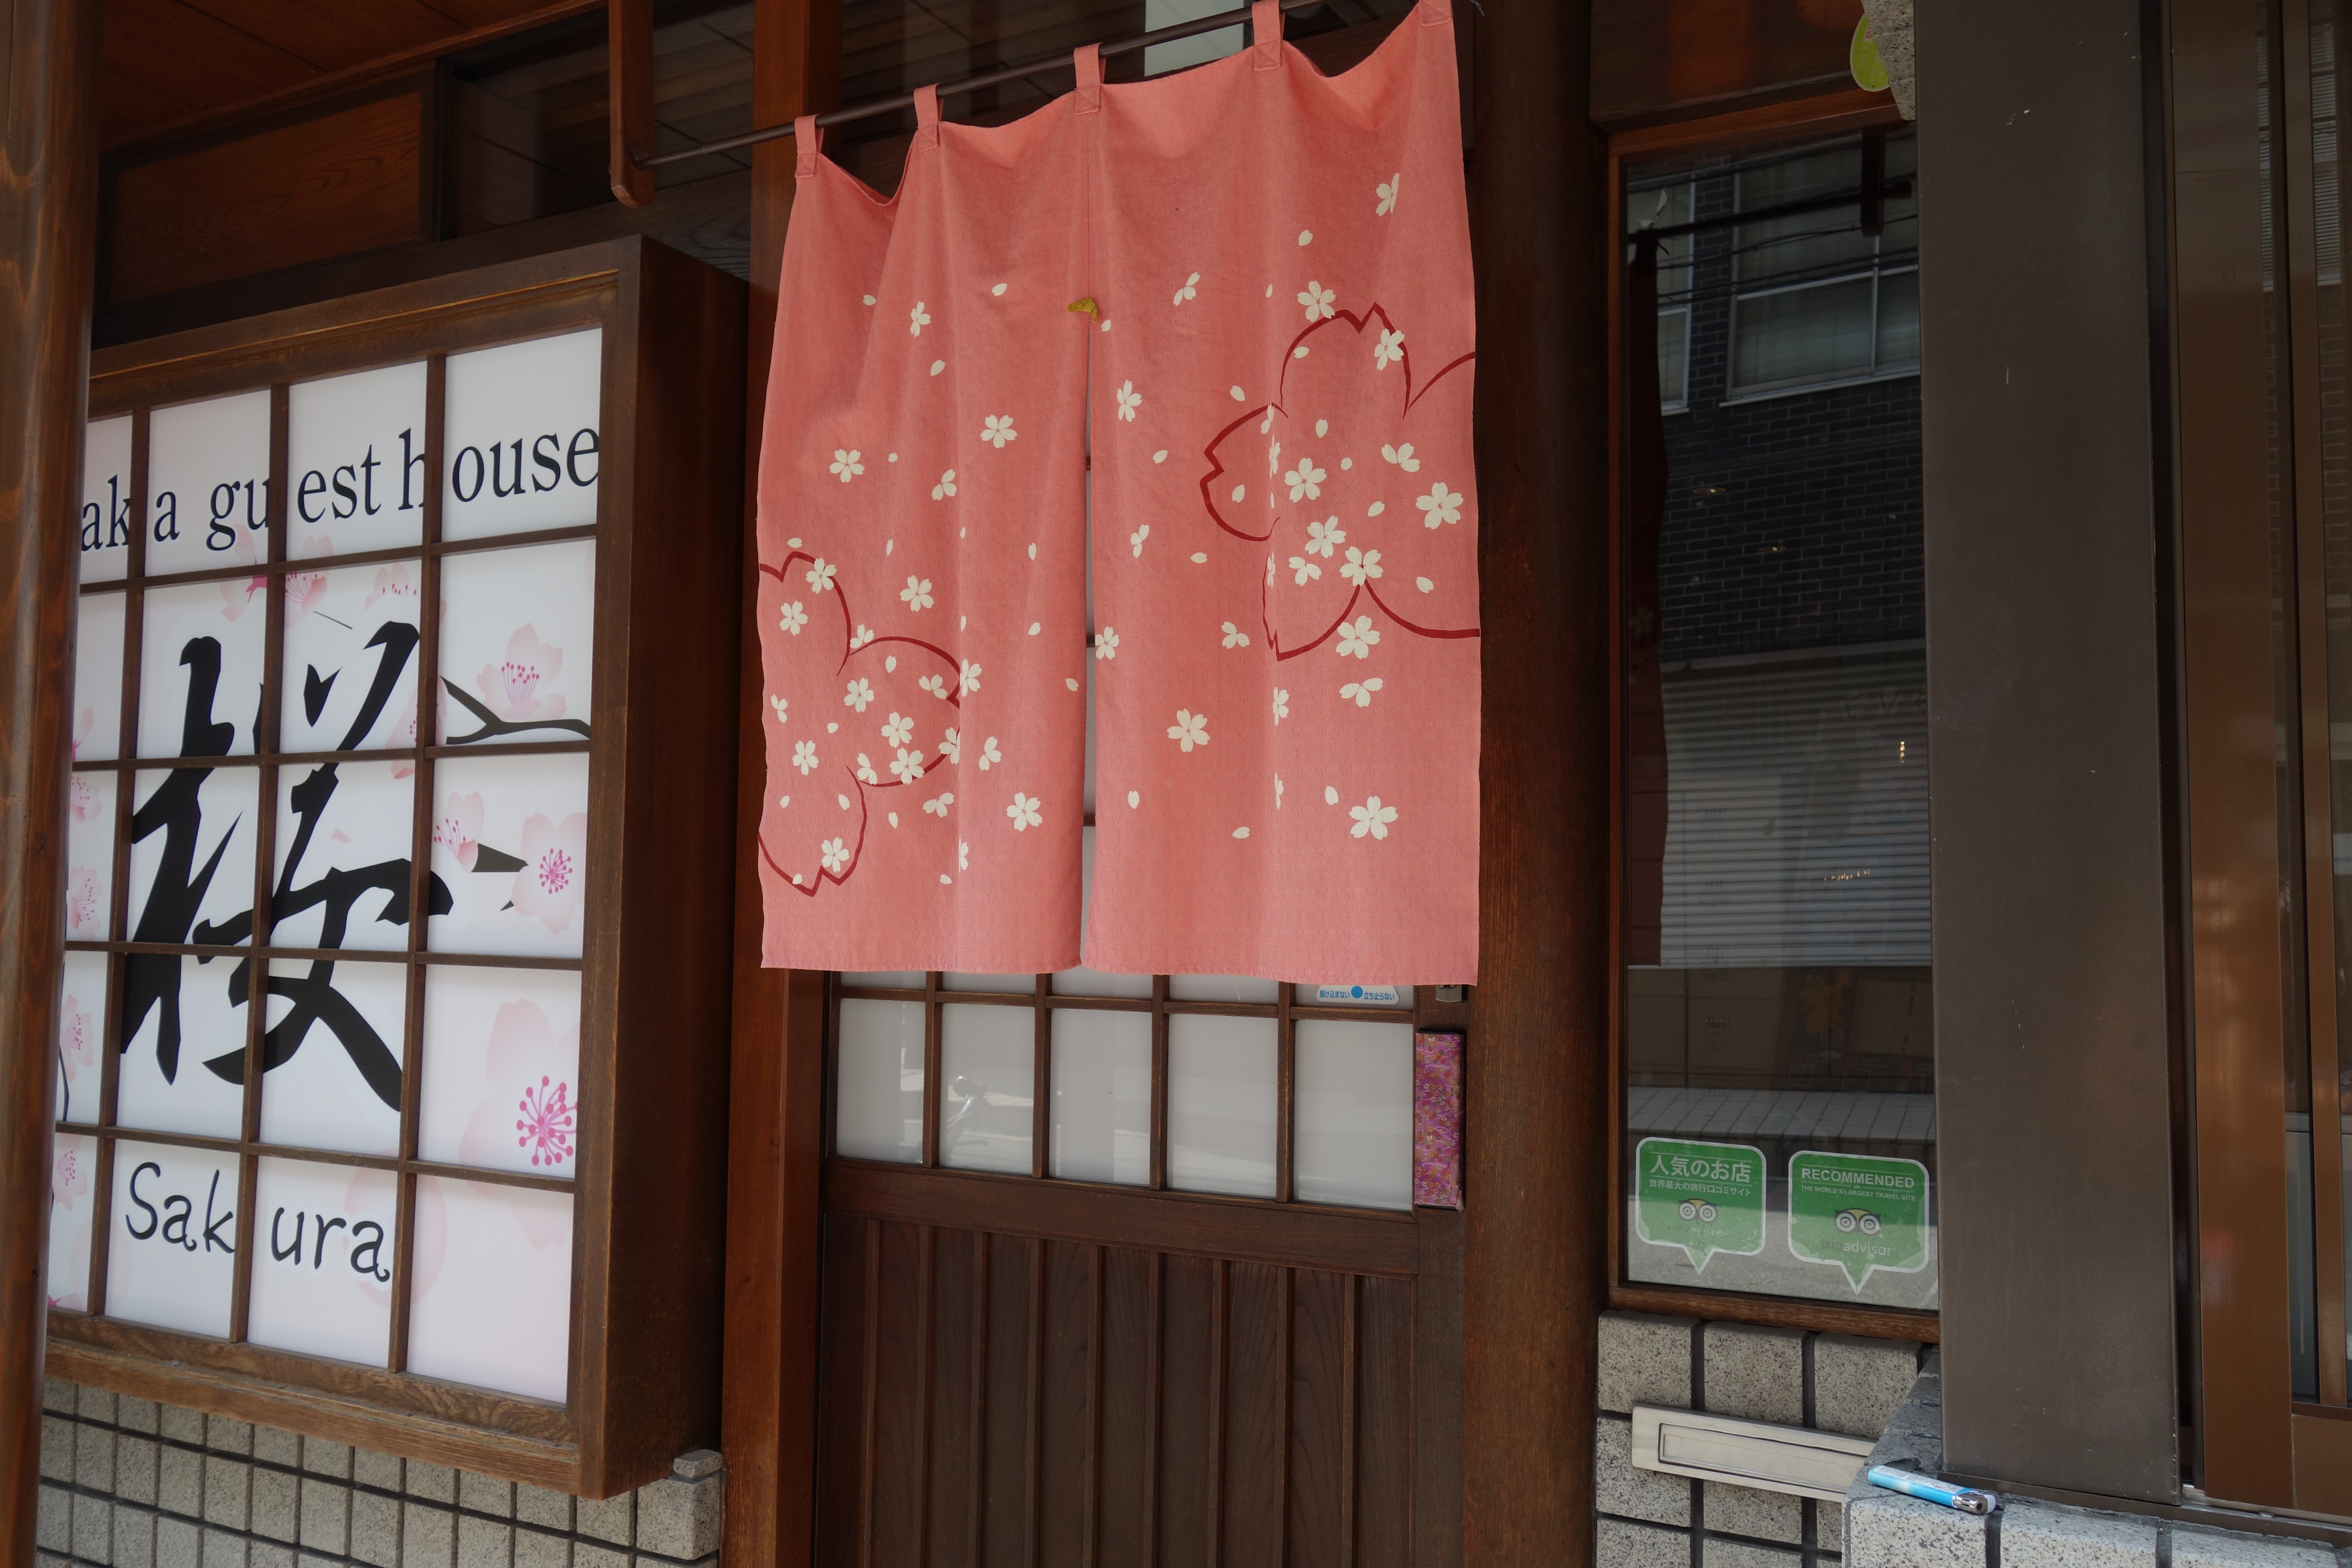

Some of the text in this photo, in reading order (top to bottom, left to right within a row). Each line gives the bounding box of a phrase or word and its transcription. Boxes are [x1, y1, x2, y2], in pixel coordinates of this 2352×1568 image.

[206, 444, 381, 551] guest
[398, 428, 599, 510] house
[1364, 992, 1395, 1000] 立ち止らない
[1650, 1155, 1752, 1183] 人気のお店
[1802, 1168, 1915, 1188] RECOMMENDED
[1649, 1179, 1752, 1197] 世界最大の旅行口コミサイト
[126, 1162, 390, 1282] Sakura
[1820, 1238, 1892, 1256] tripadvisor
